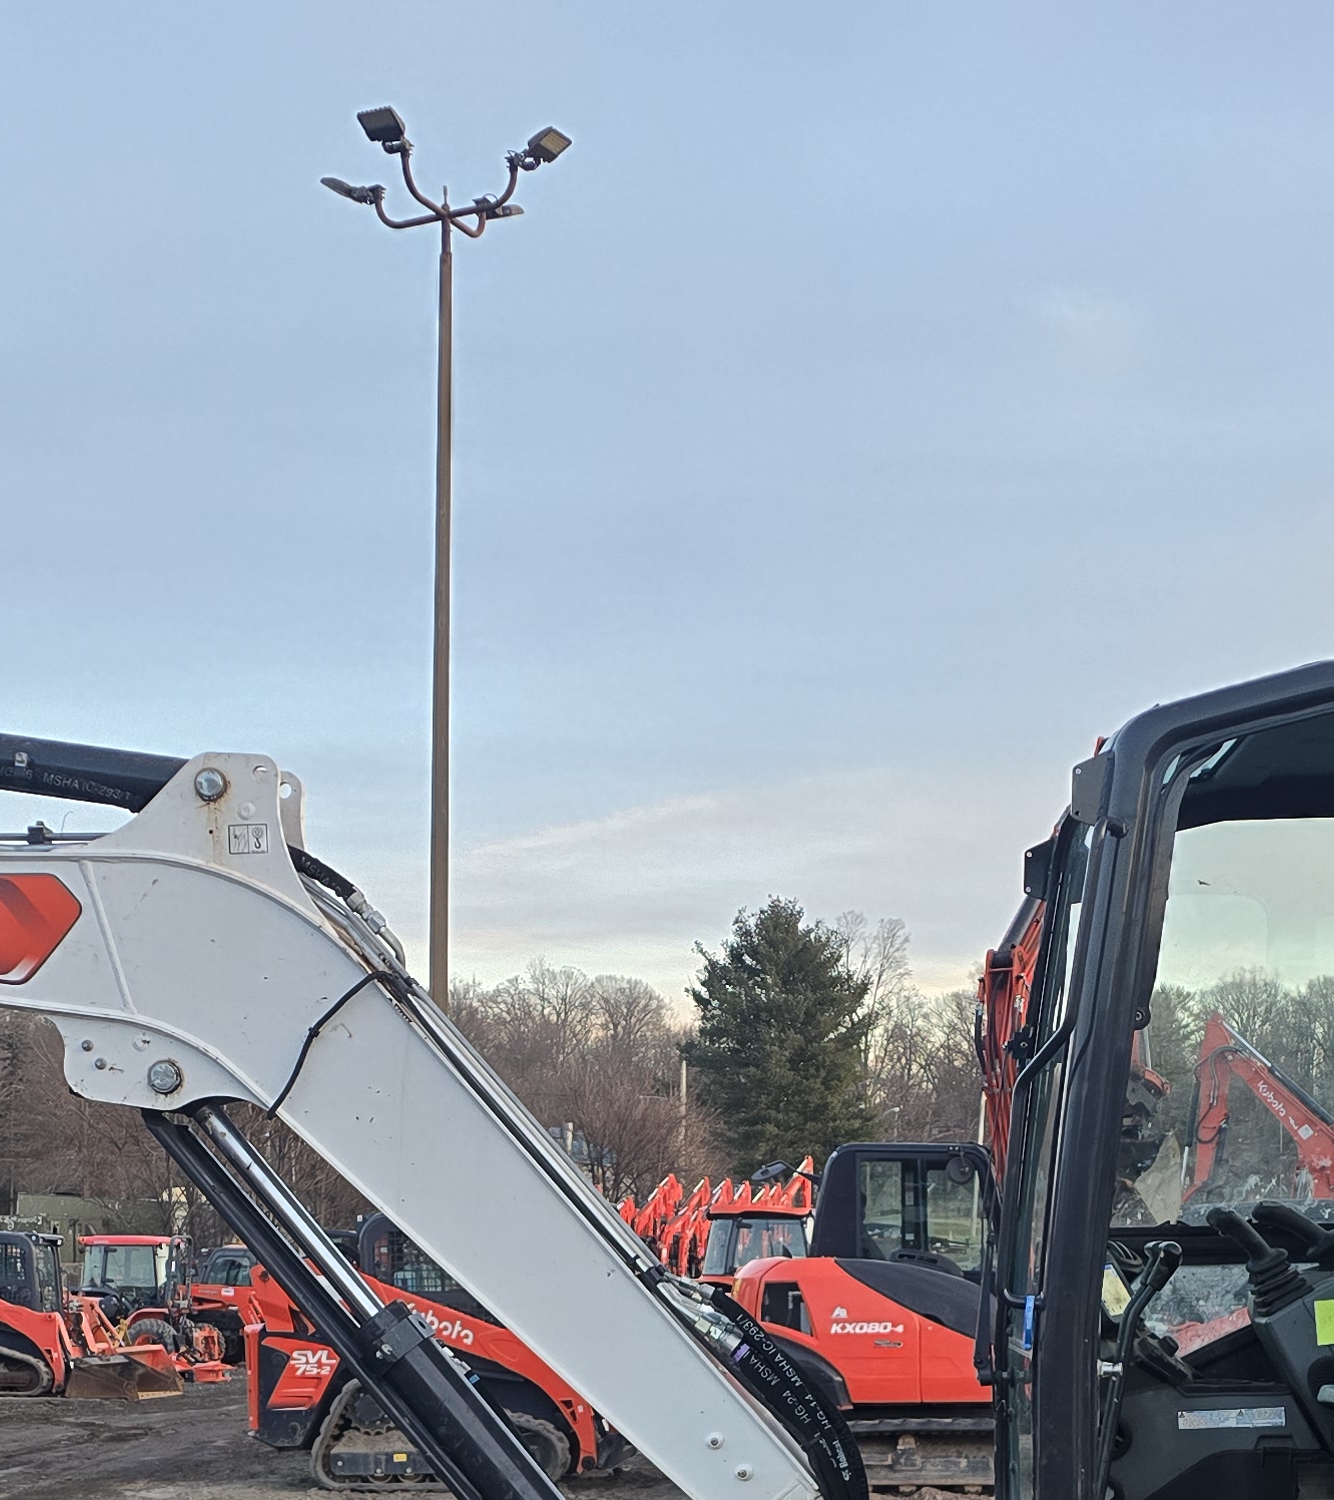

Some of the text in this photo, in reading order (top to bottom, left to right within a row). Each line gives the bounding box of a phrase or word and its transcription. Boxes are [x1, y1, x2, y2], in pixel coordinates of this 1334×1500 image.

[43, 772, 80, 789] MSHA
[1257, 1080, 1286, 1117] Kubota
[736, 1313, 777, 1355] IC-293/1
[830, 1322, 904, 1334] KX080-4
[290, 1351, 336, 1364] SVL
[295, 1364, 330, 1375] 75-2
[774, 1353, 803, 1387] MSHA
[749, 1356, 812, 1424] HG-24 MSHA
[804, 1394, 832, 1431] HG-14
